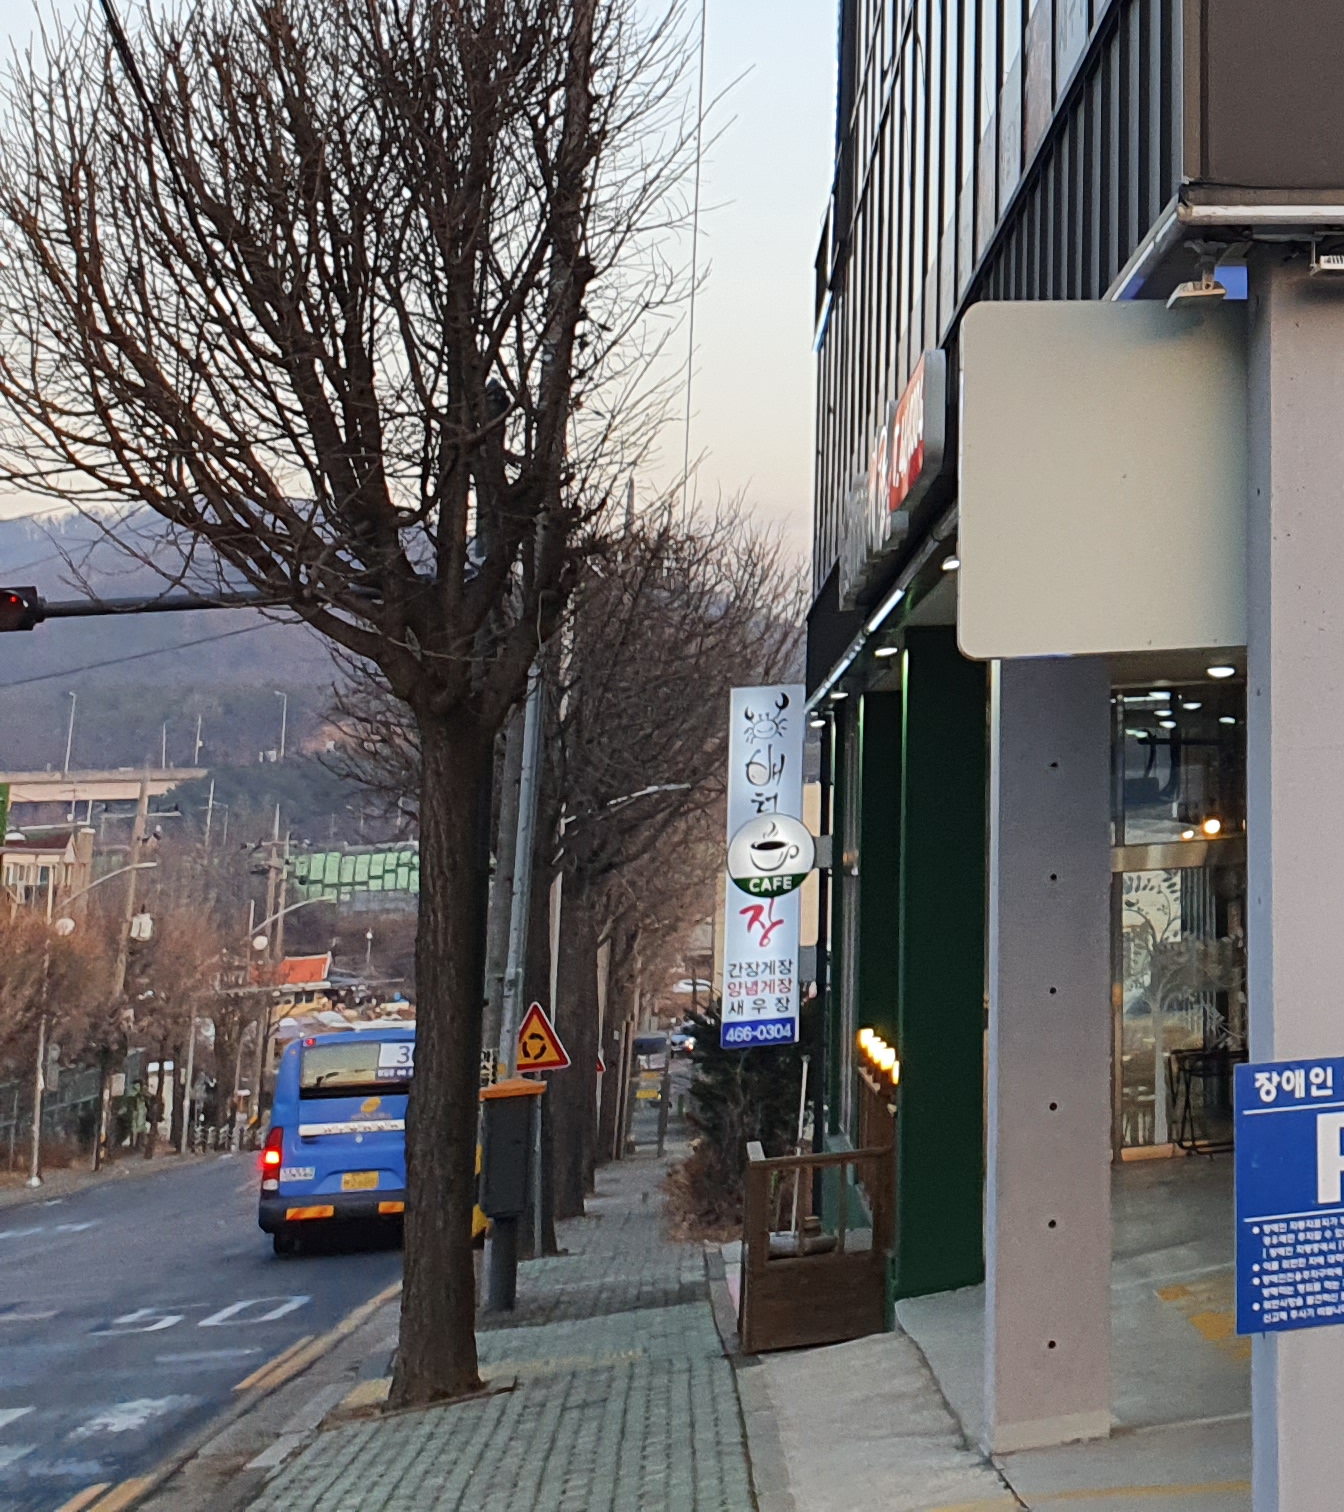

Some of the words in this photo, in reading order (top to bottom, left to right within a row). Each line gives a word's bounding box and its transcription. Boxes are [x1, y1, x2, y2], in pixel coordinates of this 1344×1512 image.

[748, 876, 793, 893] CAFE
[728, 959, 793, 979] 간장게장
[727, 978, 793, 998] 양념게장
[725, 1023, 792, 1043] 466-0304
[1254, 1065, 1334, 1103] 장애인
